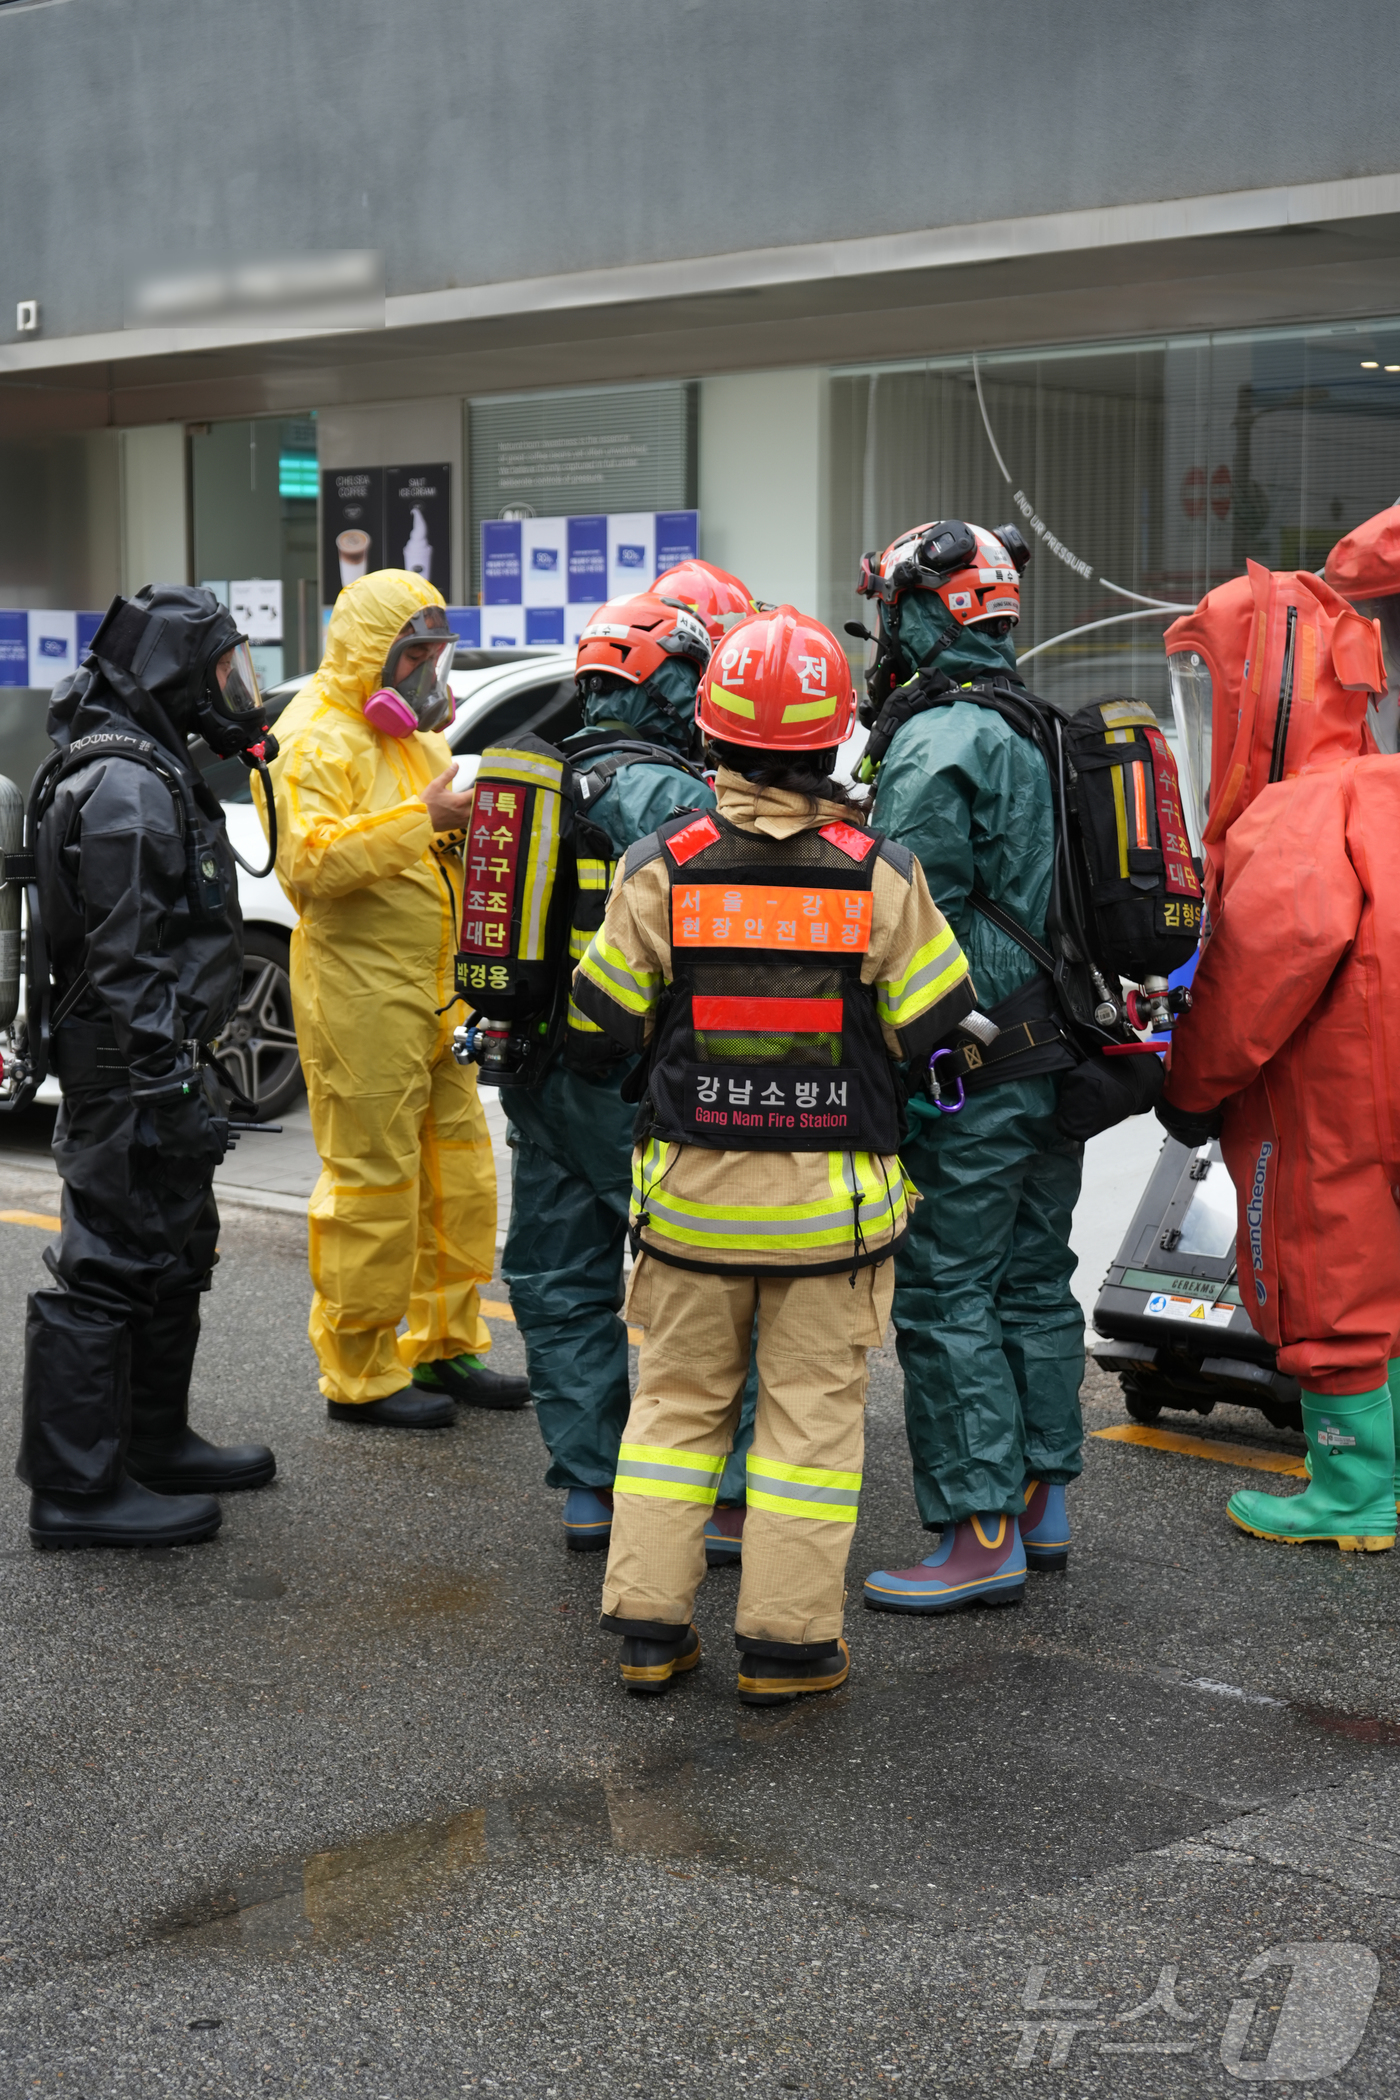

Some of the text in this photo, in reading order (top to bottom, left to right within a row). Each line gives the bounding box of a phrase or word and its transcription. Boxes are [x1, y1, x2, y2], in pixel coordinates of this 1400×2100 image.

[338, 486, 368, 498] COFFEE
[1013, 490, 1094, 579] END UR PRESSURE
[721, 647, 827, 697] 안전
[466, 790, 494, 946] 특수구조대
[484, 792, 518, 948] 특수구조단
[682, 917, 860, 945] 현장안전팀장
[457, 963, 510, 990] 박경용
[696, 1076, 848, 1108] 강남소방서
[695, 1106, 848, 1128] Gang Nam Fire Station
[1247, 1141, 1273, 1271] SanCheong
